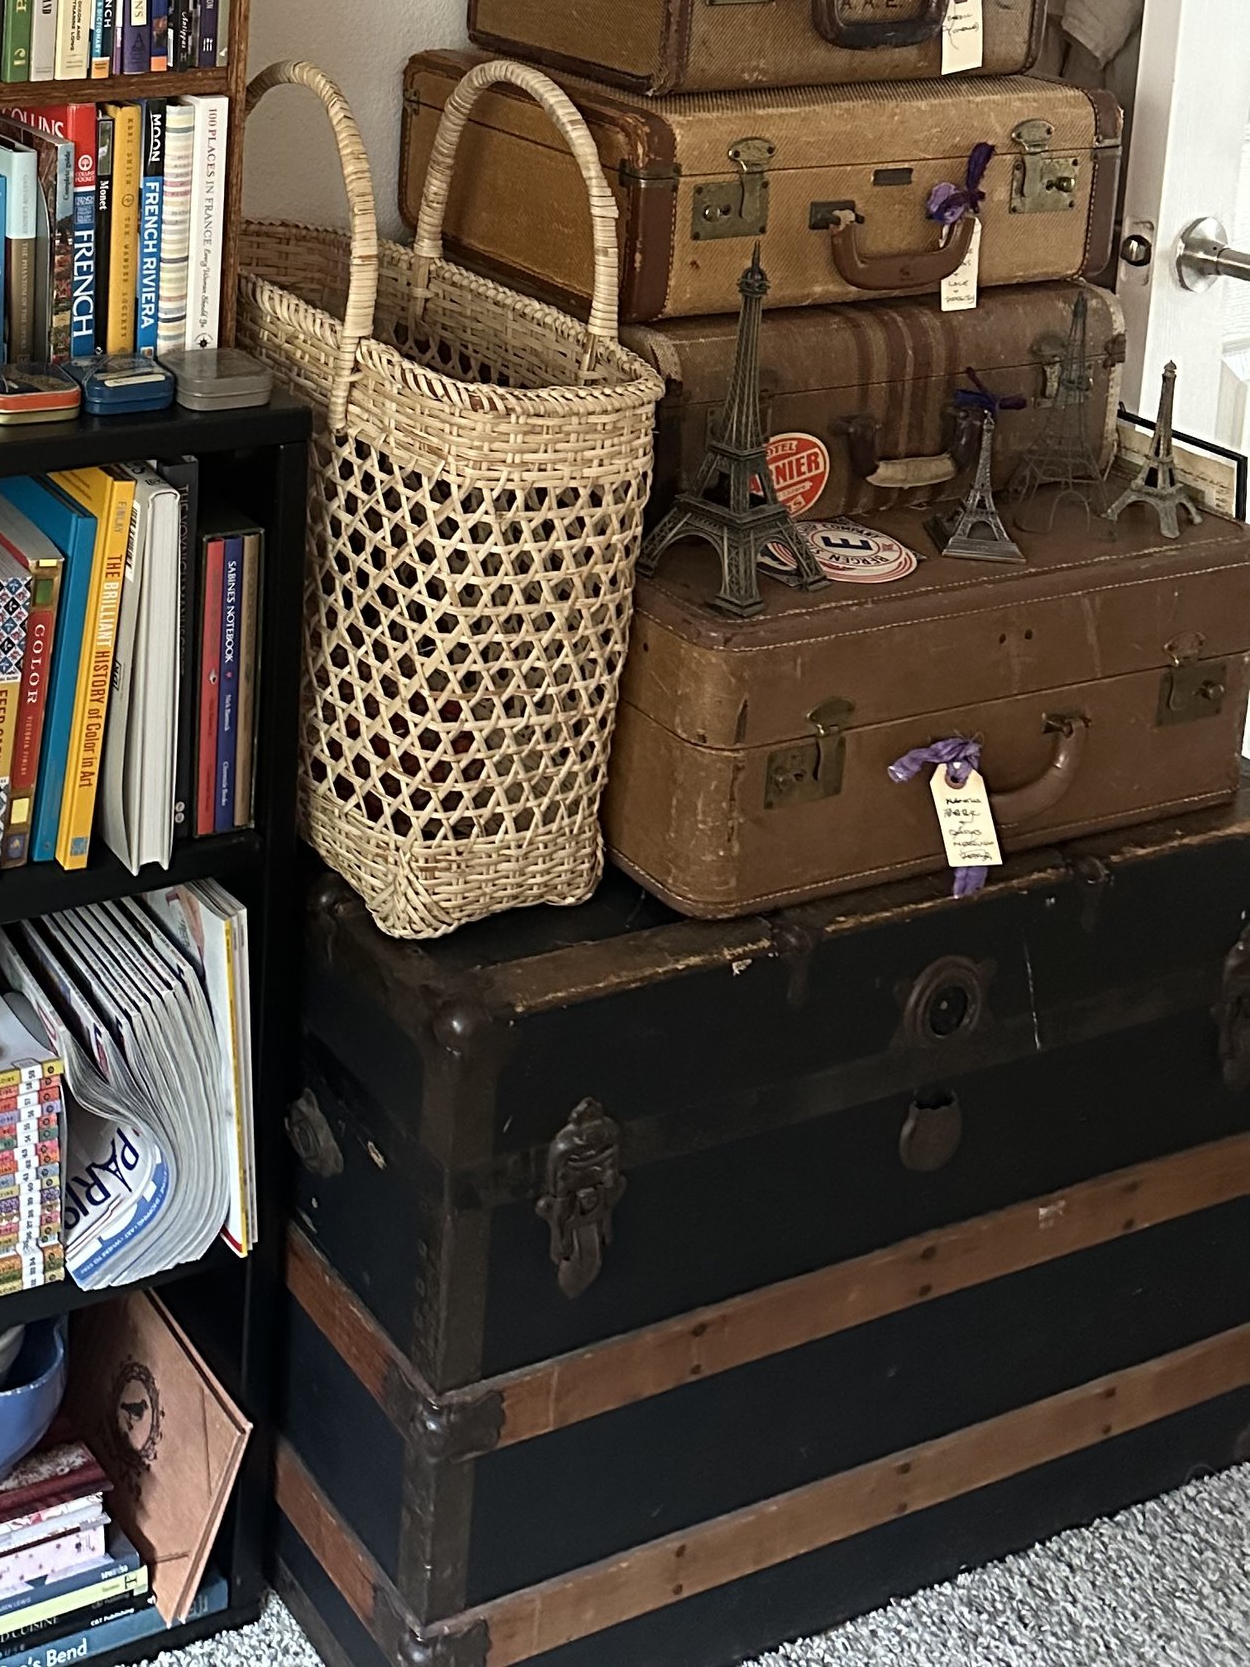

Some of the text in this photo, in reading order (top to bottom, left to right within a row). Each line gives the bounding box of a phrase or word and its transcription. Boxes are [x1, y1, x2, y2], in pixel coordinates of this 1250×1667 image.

[151, 113, 162, 162] MOON
[99, 180, 109, 210] Monet
[72, 229, 95, 337] FRENCH
[141, 181, 160, 329] FRENCH RIVIERA
[26, 624, 46, 705] COLOR
[47, 1638, 88, 1666] Bend
